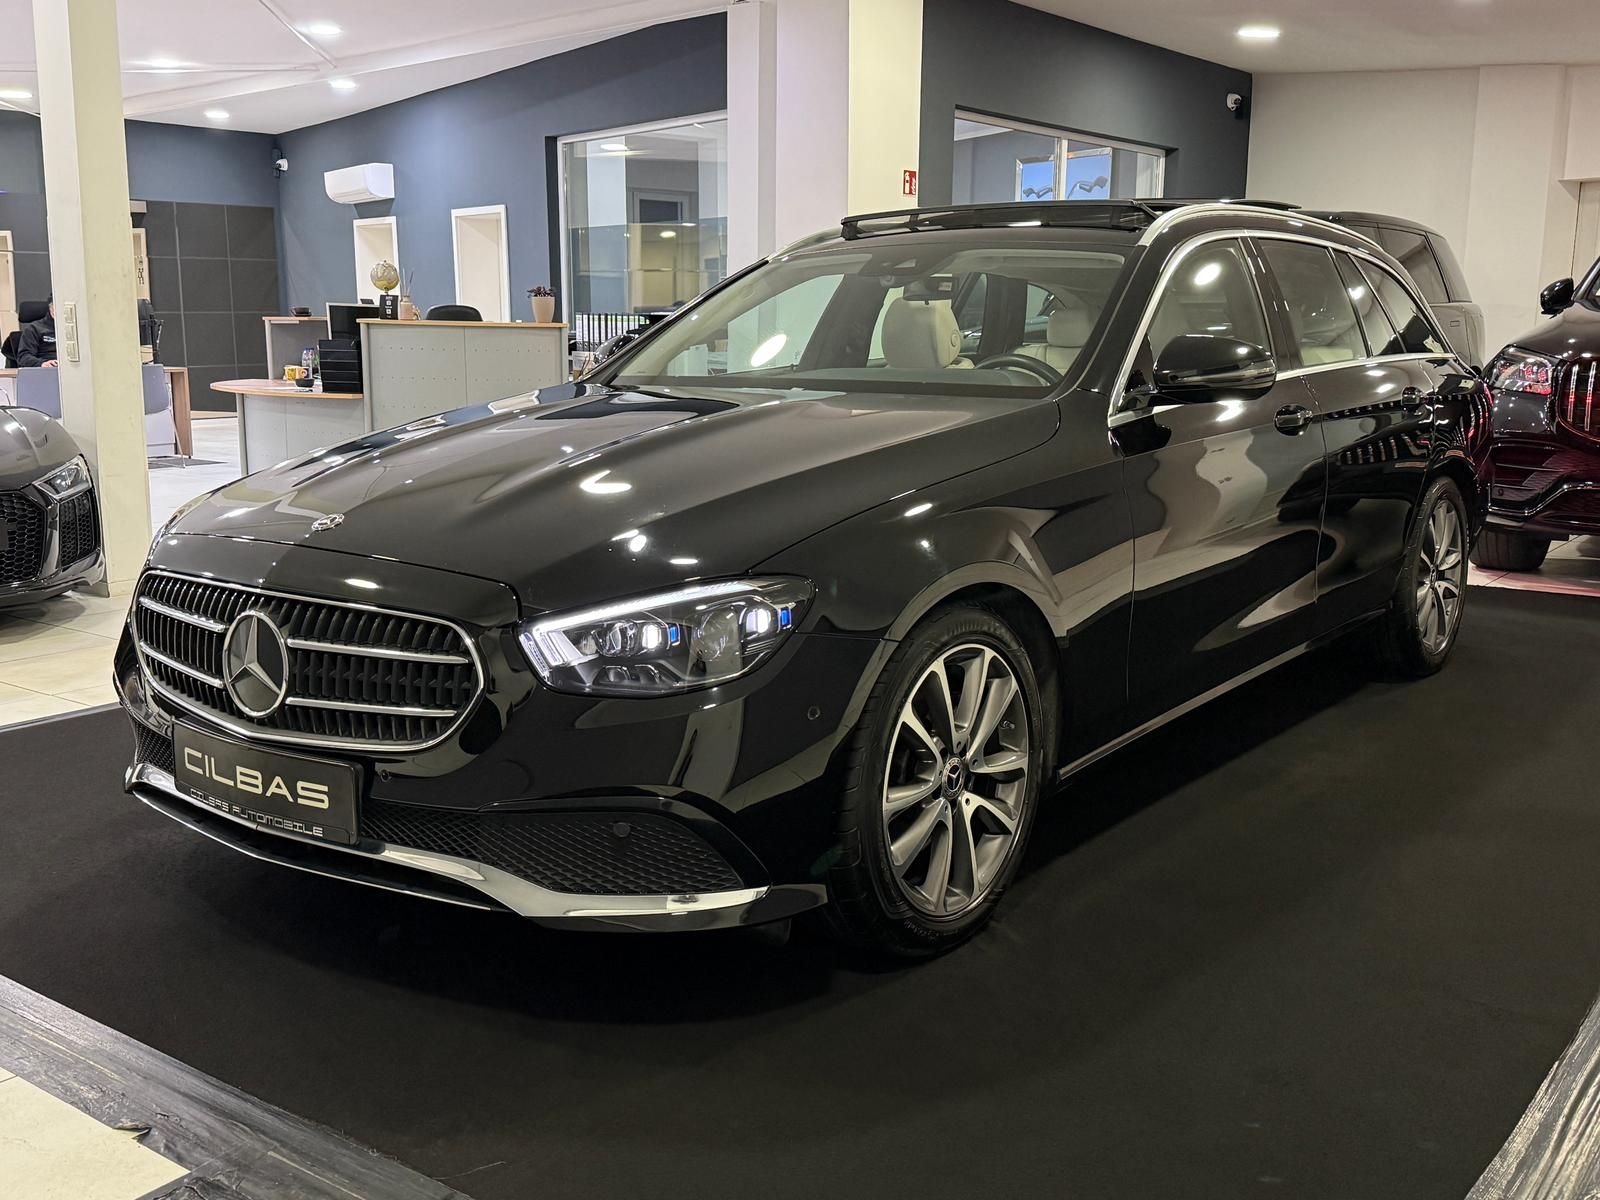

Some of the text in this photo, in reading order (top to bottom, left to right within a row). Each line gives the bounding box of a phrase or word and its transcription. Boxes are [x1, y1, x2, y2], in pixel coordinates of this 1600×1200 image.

[184, 747, 329, 809] CILBAS
[190, 788, 323, 837] CILBAS AUTOMOBILE
